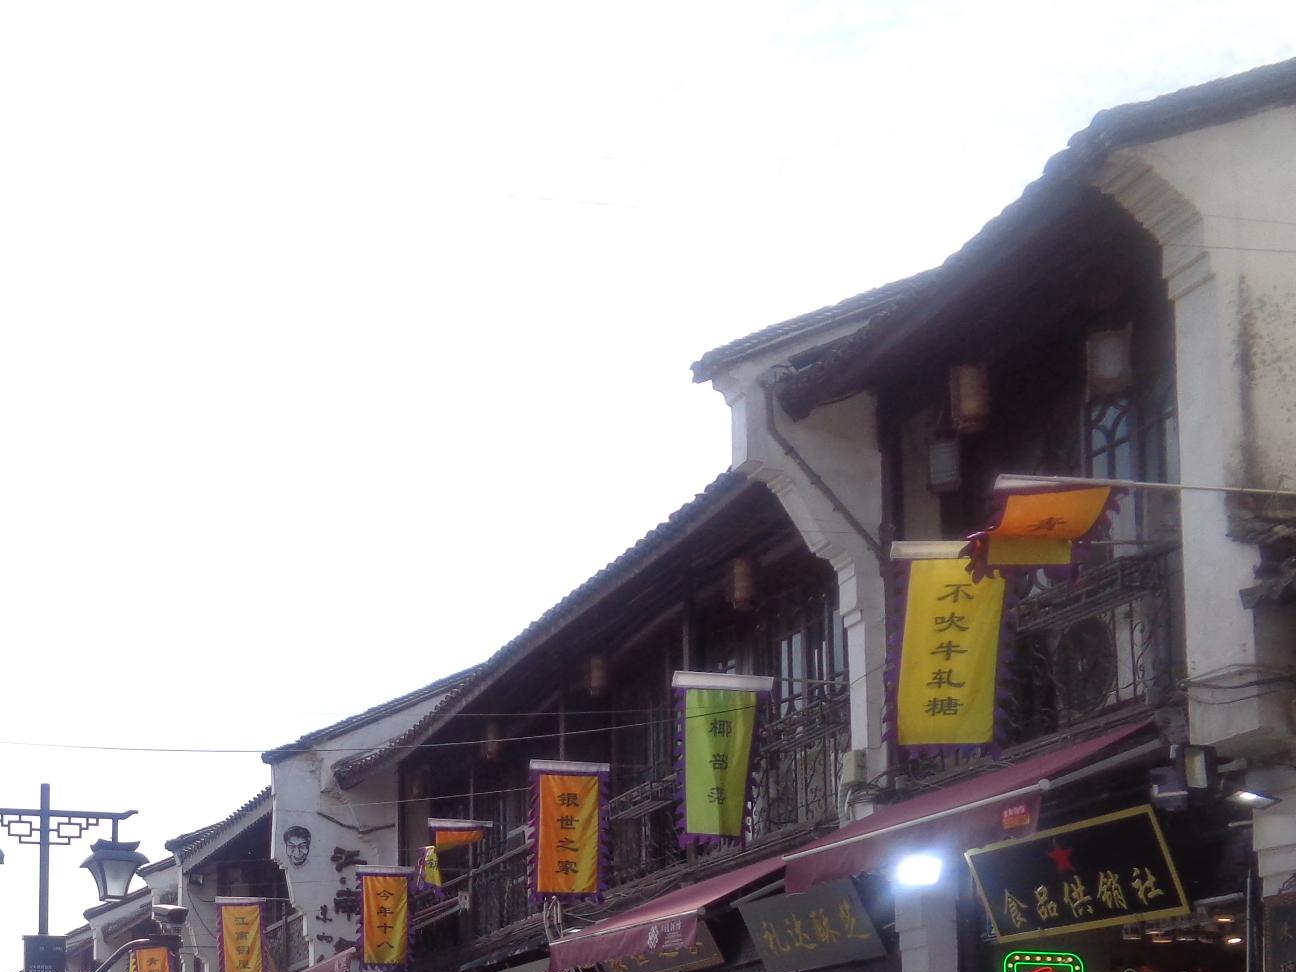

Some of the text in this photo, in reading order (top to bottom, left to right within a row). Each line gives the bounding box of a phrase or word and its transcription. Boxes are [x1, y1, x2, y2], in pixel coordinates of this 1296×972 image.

[924, 583, 974, 717] 不吹牛轧糖
[706, 718, 733, 806] 椰部落
[554, 792, 580, 875] 银世之家
[234, 917, 252, 970] 江南铜屋
[376, 889, 395, 949] 今年十八
